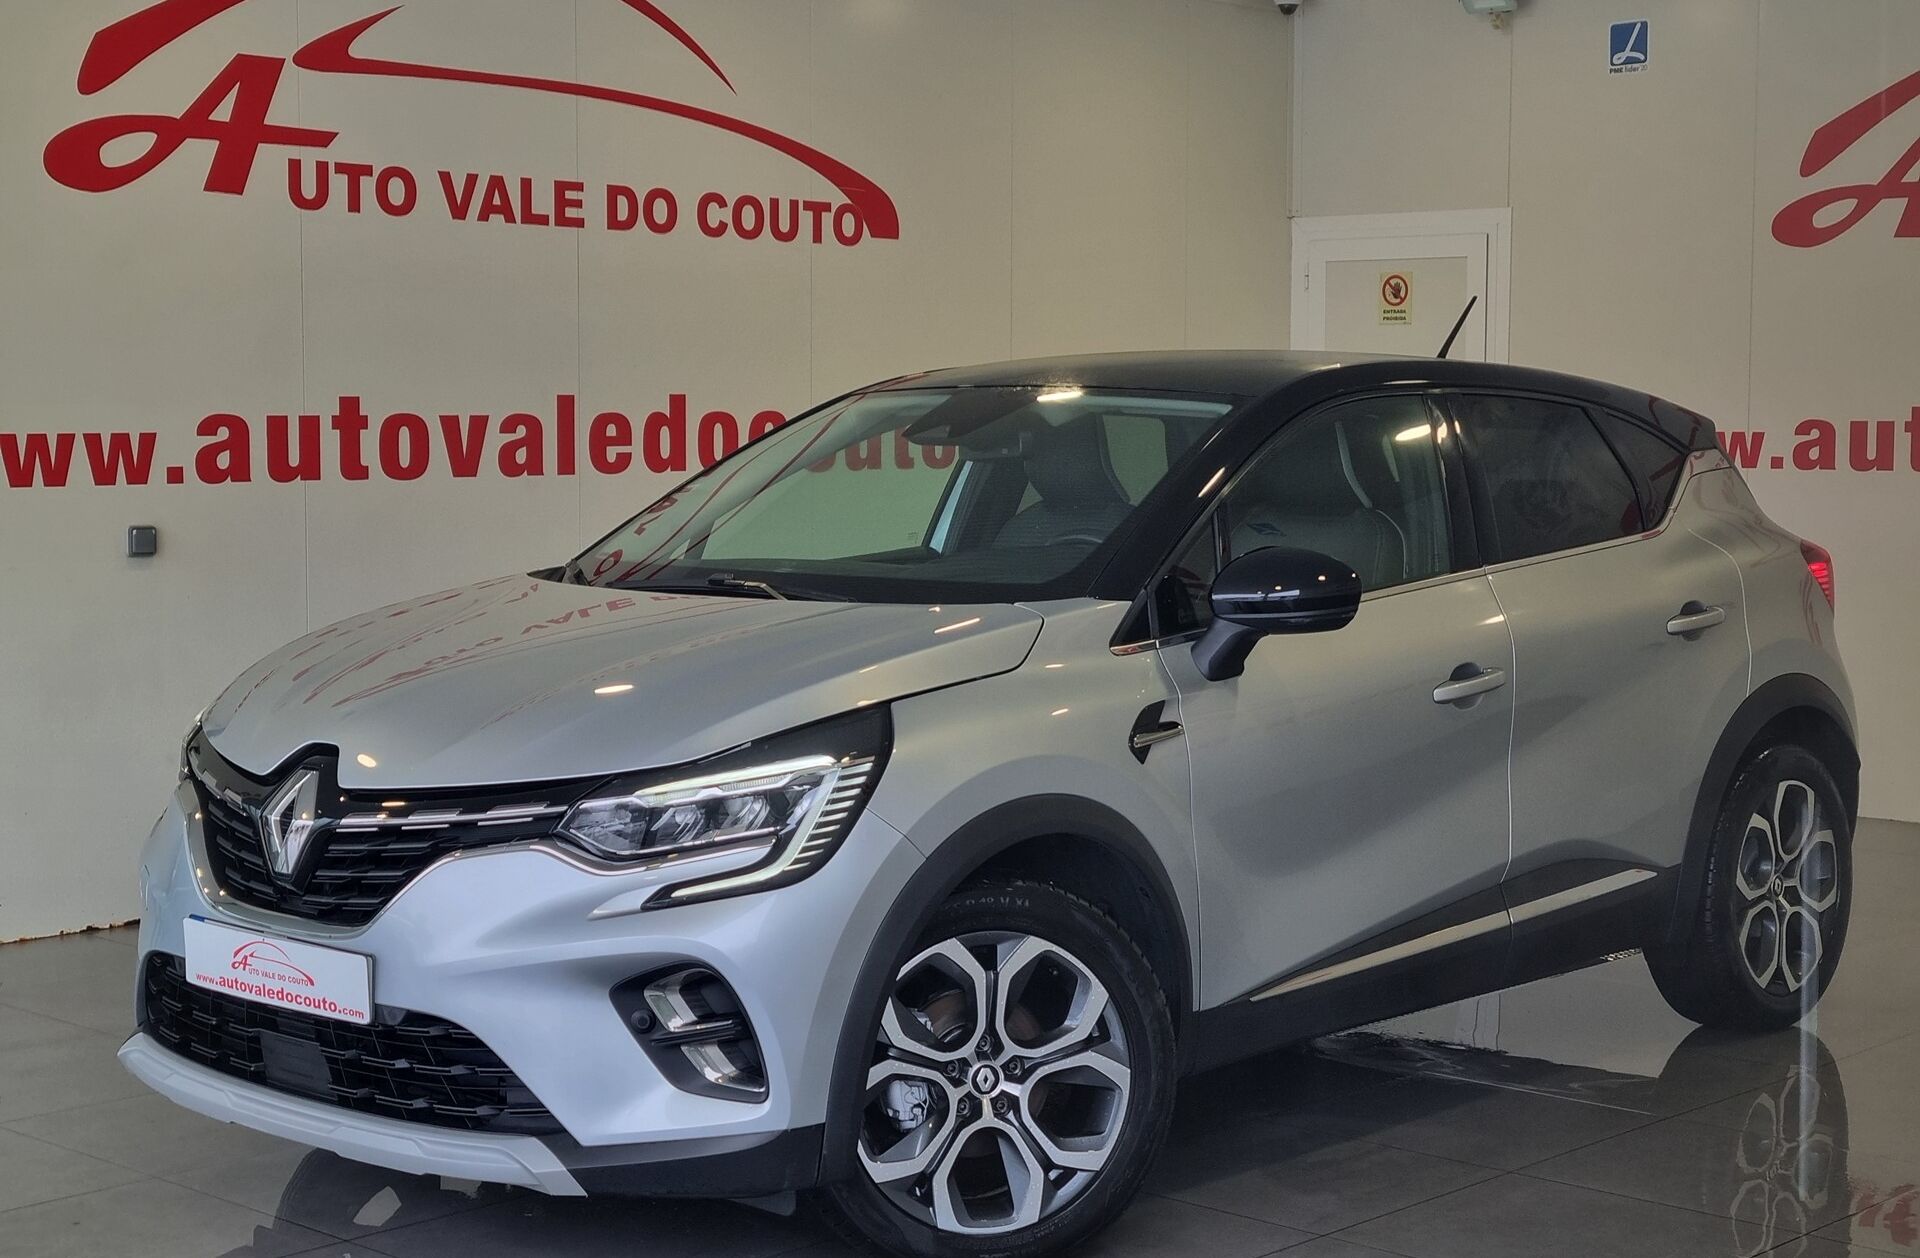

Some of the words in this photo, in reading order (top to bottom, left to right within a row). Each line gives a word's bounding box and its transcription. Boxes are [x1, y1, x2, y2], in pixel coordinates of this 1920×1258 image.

[438, 170, 585, 228] VALE
[606, 184, 678, 235] DO
[697, 192, 864, 246] COUTO
[195, 973, 365, 1019] www.autovaledocouto.com
[260, 970, 276, 980] VALE
[277, 973, 287, 982] DO
[287, 975, 309, 987] COUTO
